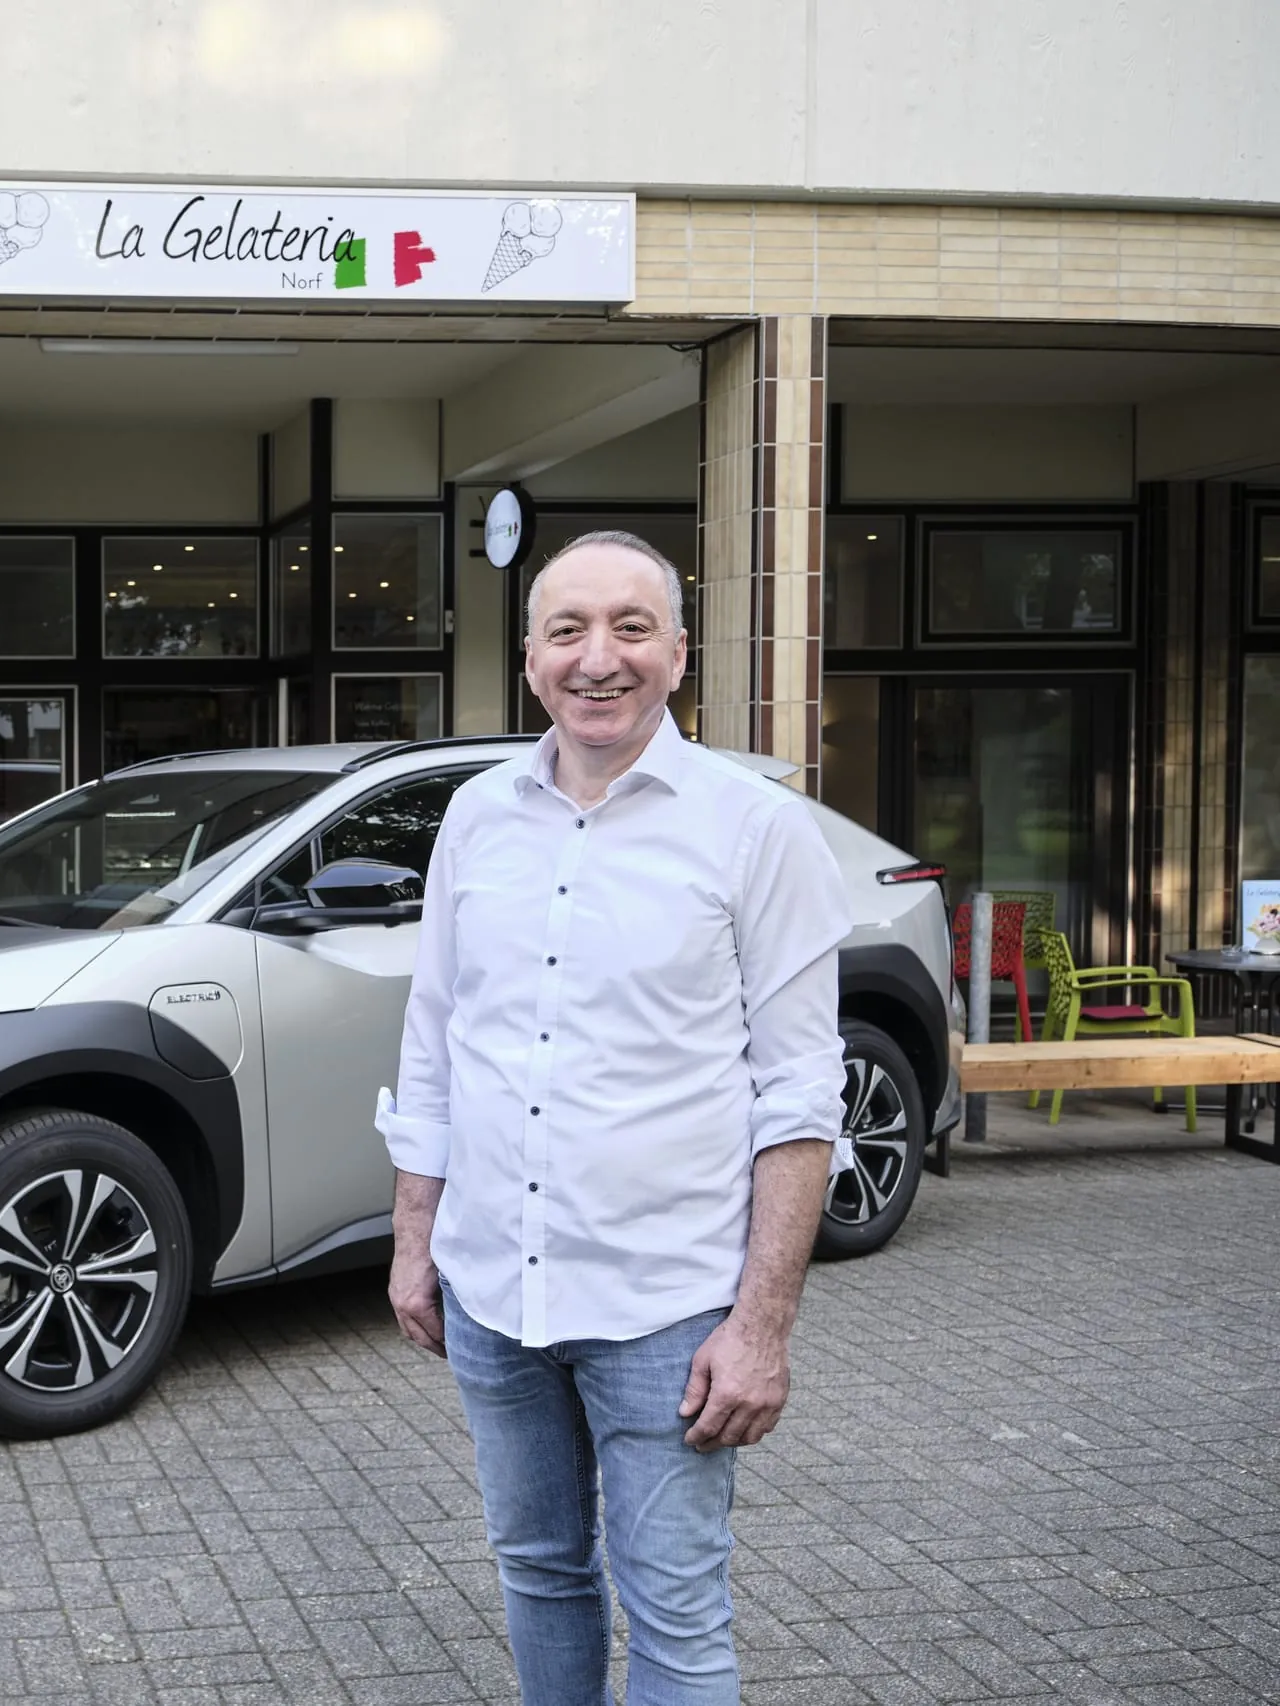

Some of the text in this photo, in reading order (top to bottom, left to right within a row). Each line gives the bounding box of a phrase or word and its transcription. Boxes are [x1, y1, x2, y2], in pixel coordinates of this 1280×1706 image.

[95, 196, 357, 262] La Gelateria
[282, 272, 324, 289] Norf
